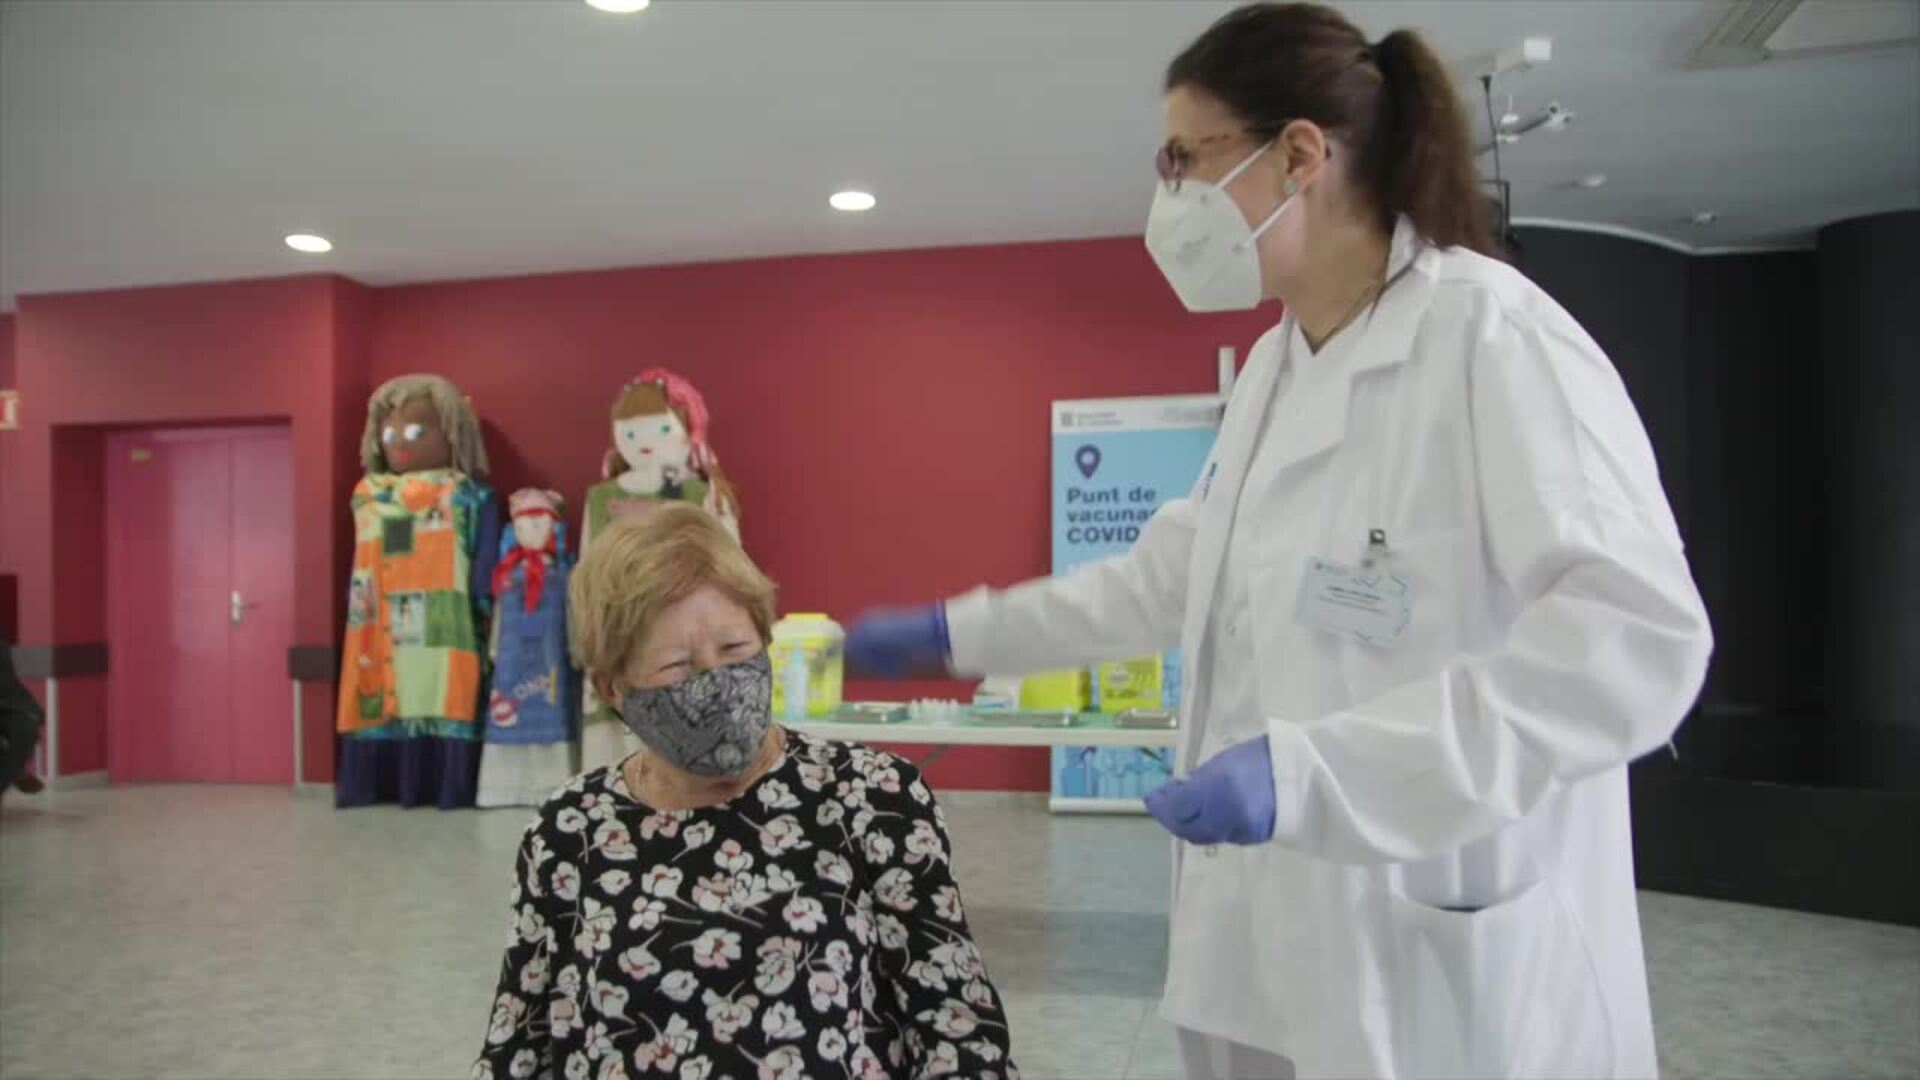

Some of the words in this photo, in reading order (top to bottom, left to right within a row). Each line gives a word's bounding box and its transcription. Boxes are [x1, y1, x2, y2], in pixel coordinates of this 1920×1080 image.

[1067, 488, 1120, 503] Punt
[1128, 486, 1157, 502] de
[1067, 527, 1140, 543] COVID
